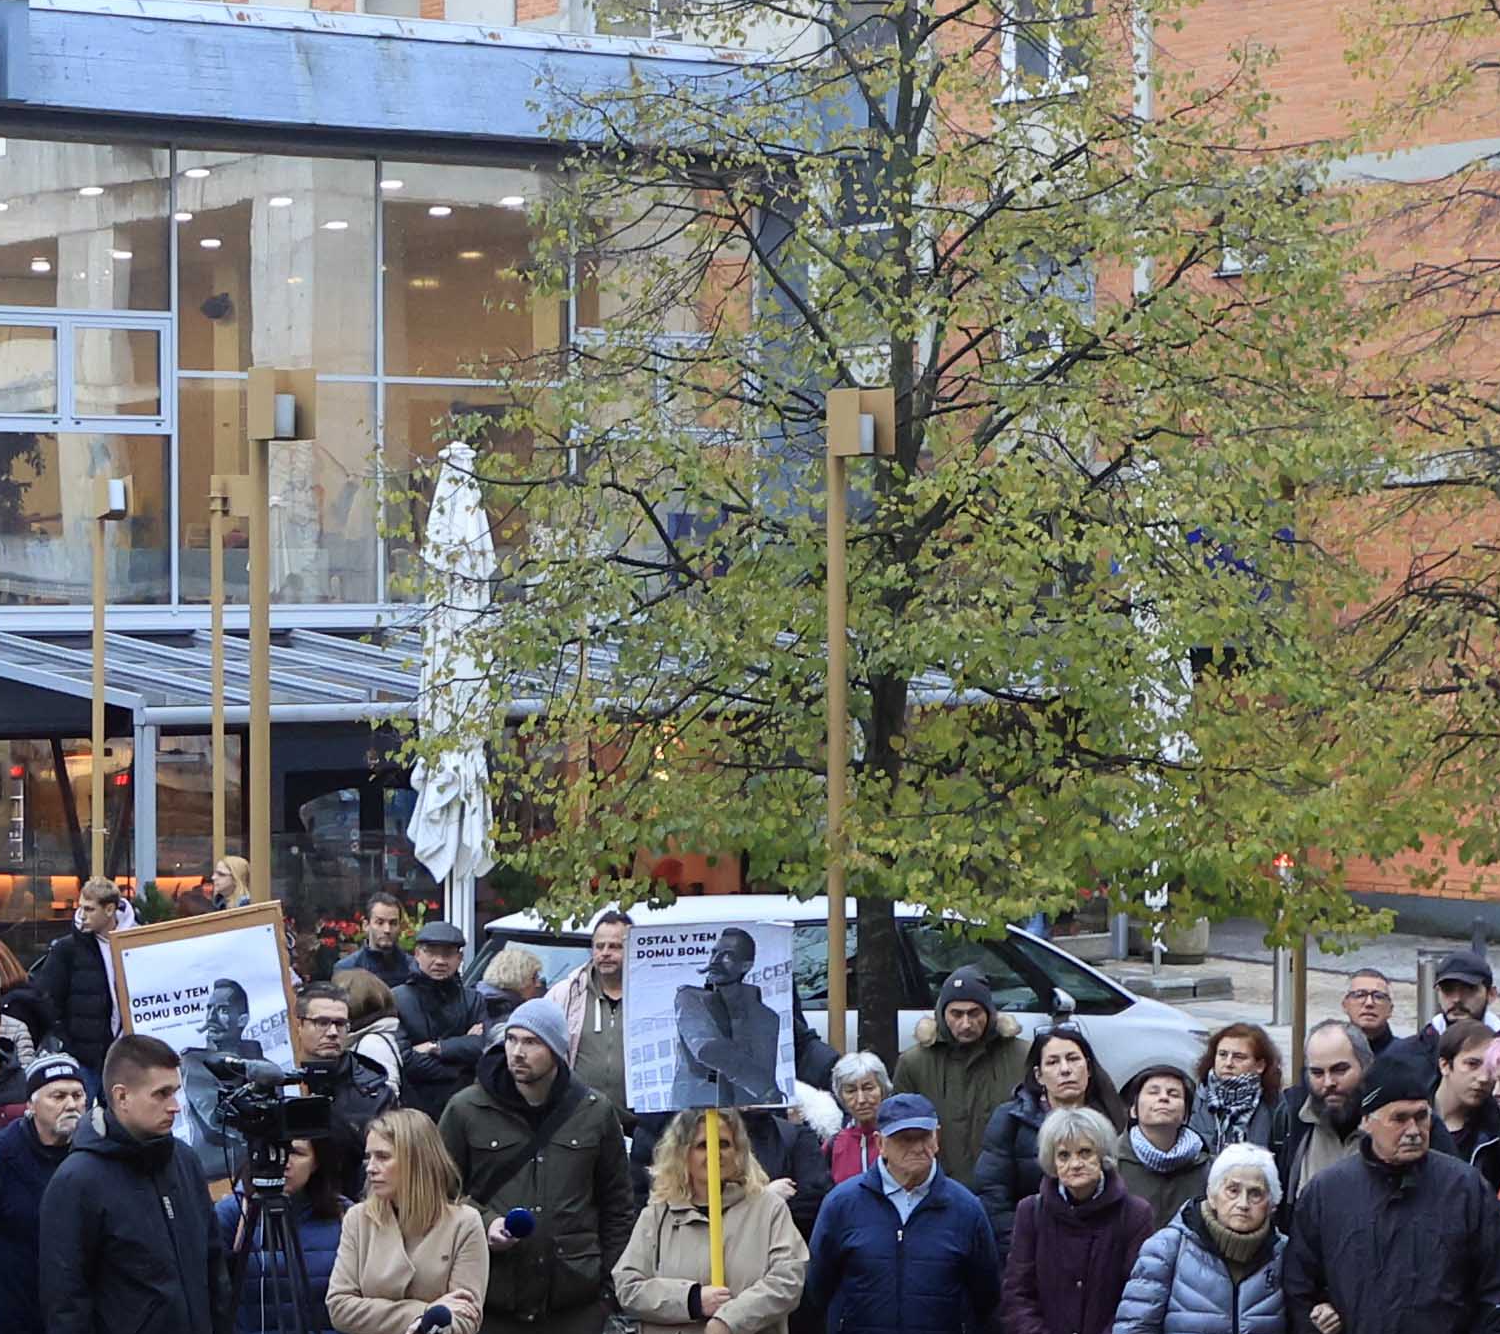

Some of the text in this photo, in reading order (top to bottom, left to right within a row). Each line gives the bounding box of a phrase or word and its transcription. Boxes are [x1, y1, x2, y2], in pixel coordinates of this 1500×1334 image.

[637, 932, 717, 946] OSTAL V TEM
[636, 946, 710, 959] DOMU BOM.
[132, 986, 210, 1008] OSTAL V TEM
[134, 1004, 204, 1023] DOMU BOM.
